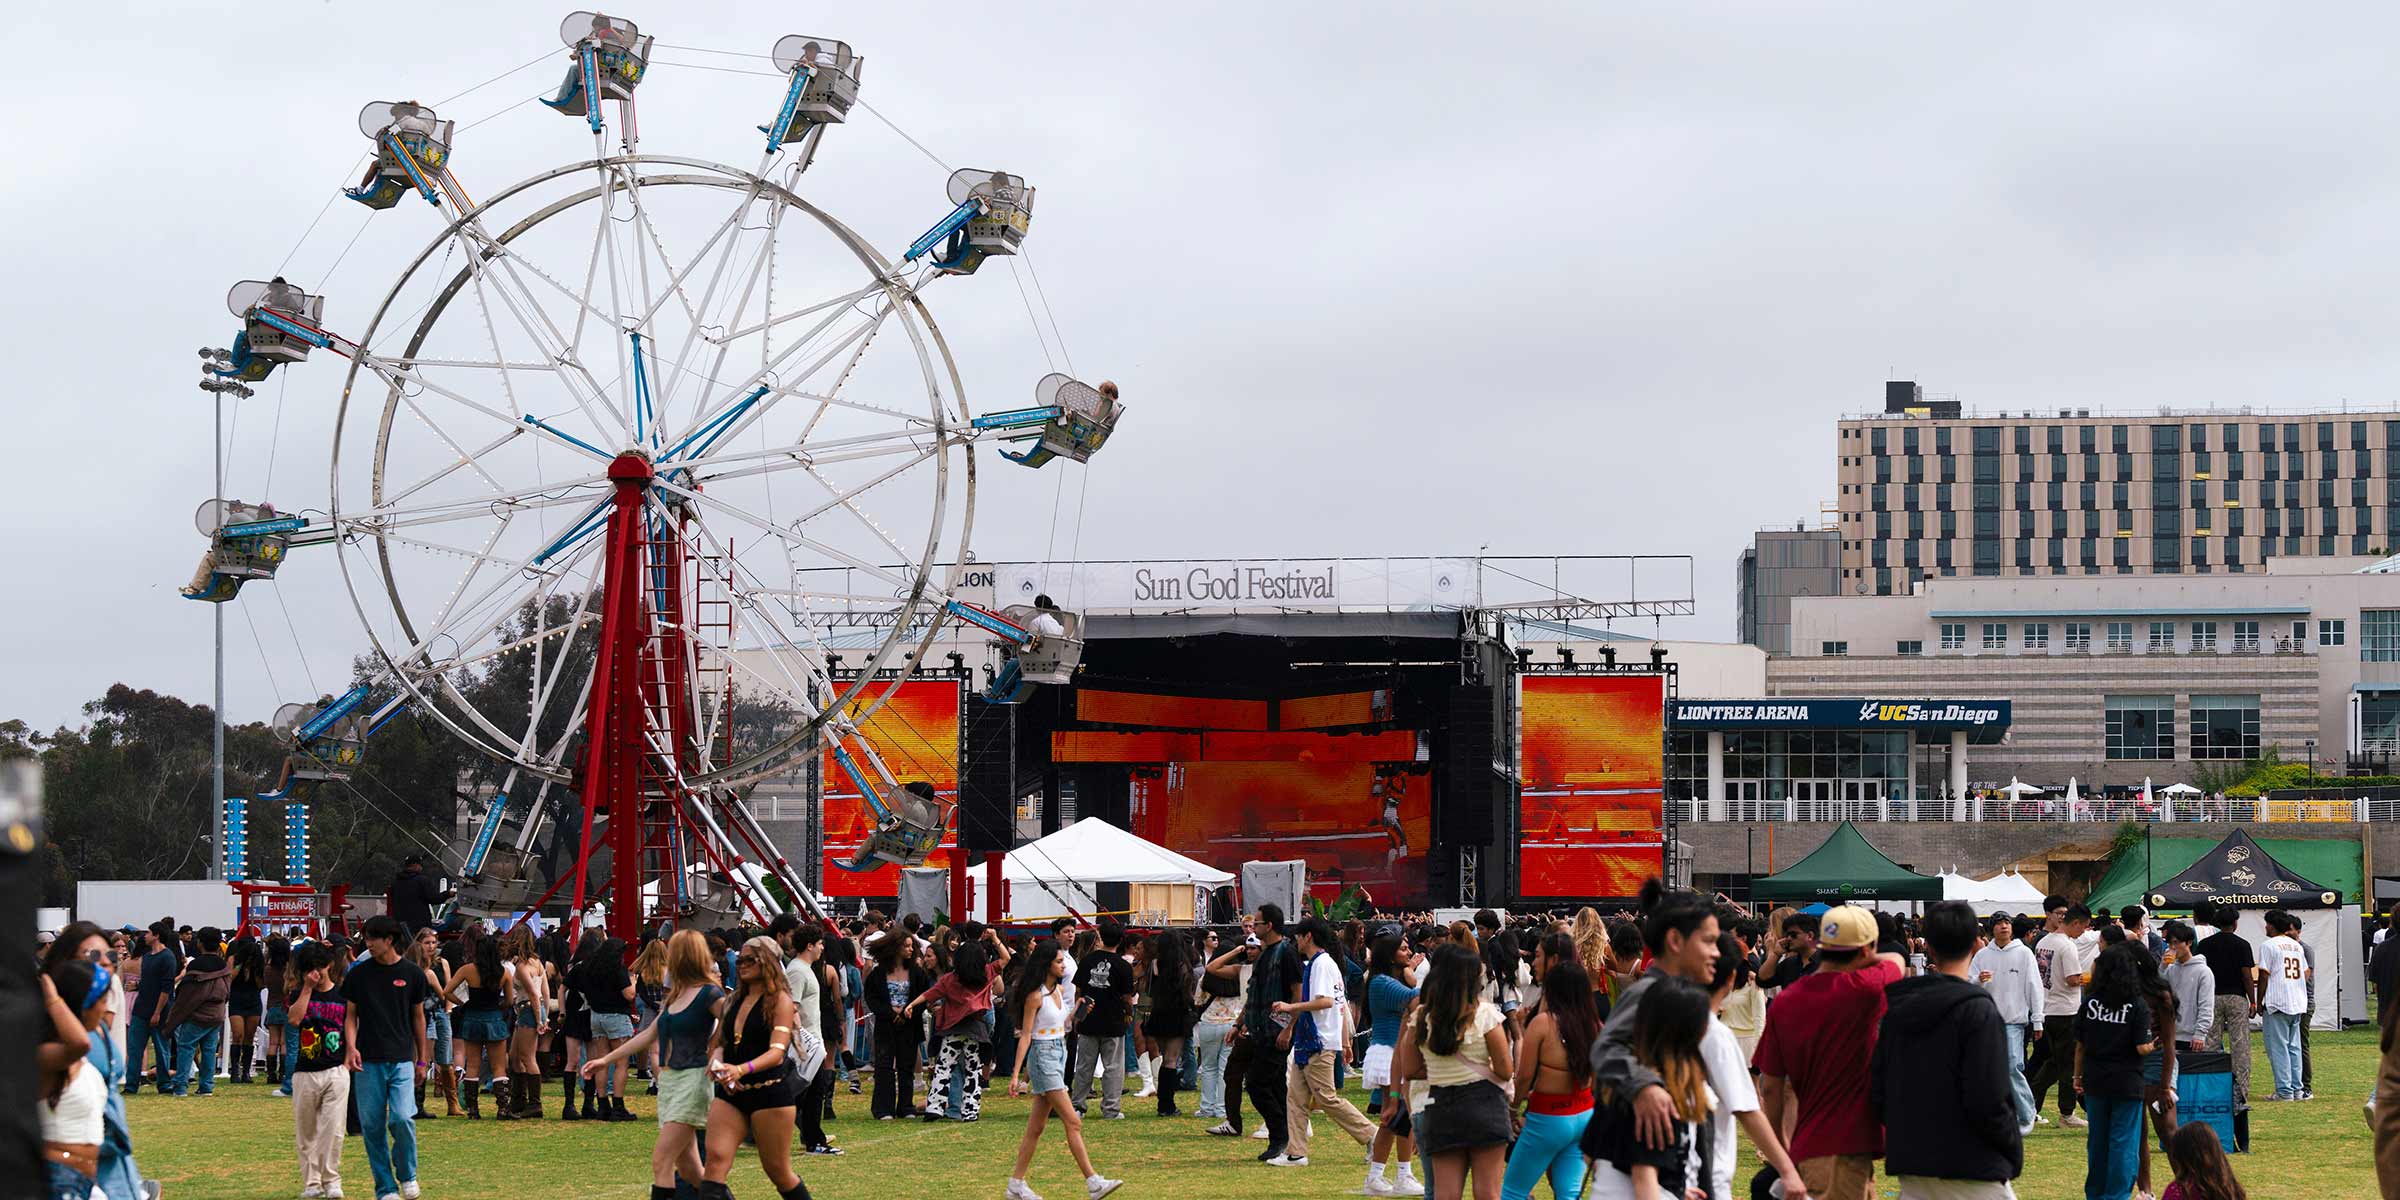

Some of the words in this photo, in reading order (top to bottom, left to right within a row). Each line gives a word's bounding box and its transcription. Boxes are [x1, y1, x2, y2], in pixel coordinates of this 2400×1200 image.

[1135, 568, 1182, 601] Sun
[1187, 567, 1240, 601] God
[1245, 566, 1335, 600] Festival
[1677, 706, 1754, 720] LIONTREE
[1754, 706, 1809, 720] ARENA
[2208, 893, 2279, 905] Postmates
[268, 901, 314, 912] ENTRANCE
[2284, 957, 2300, 980] 23
